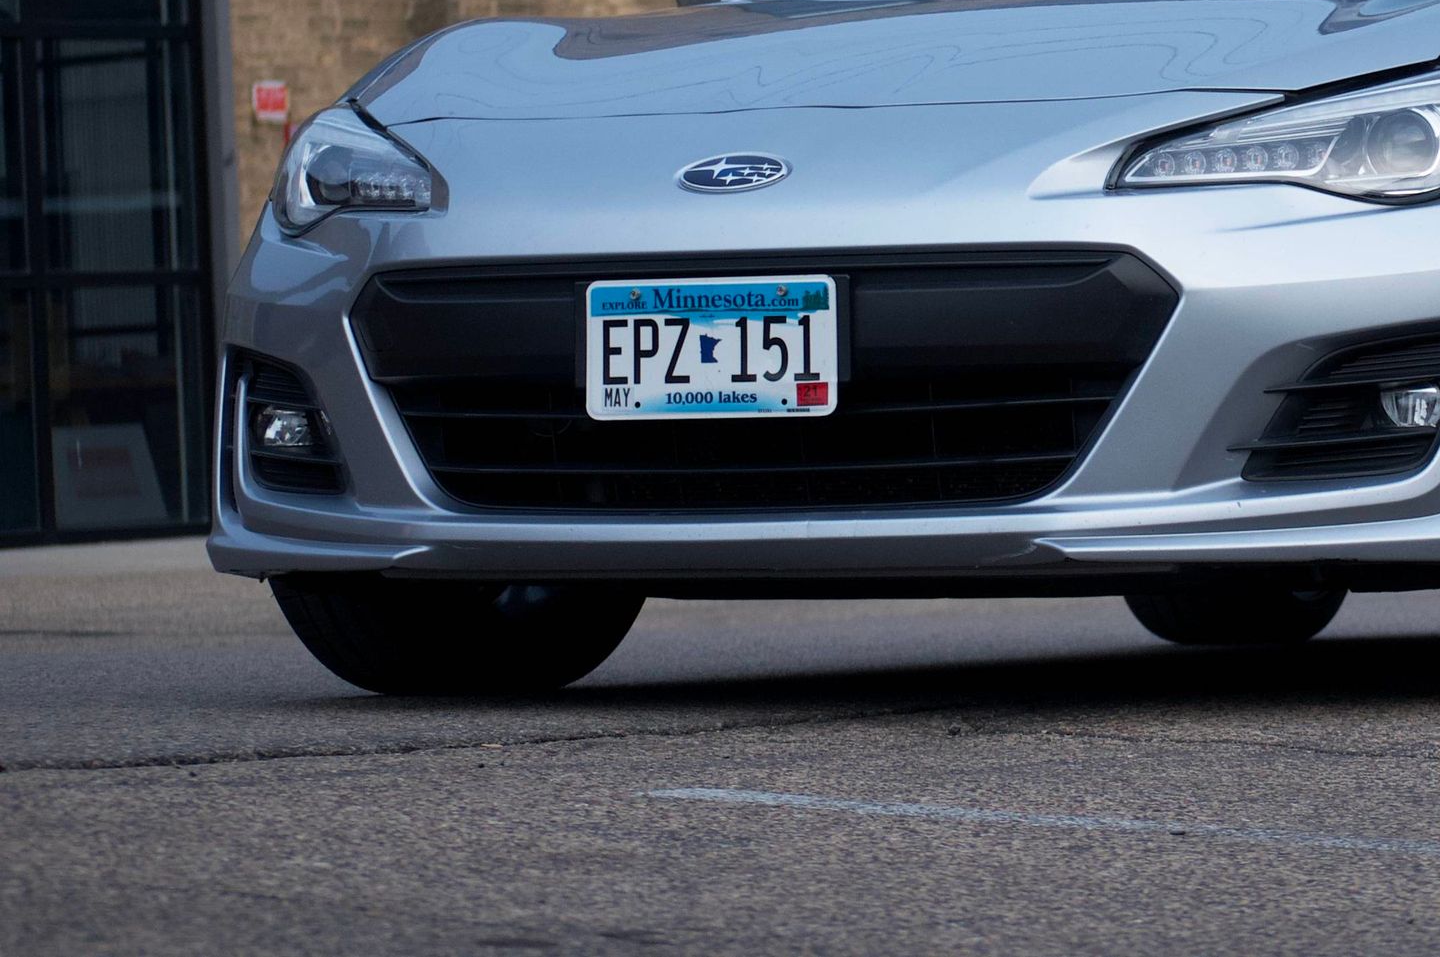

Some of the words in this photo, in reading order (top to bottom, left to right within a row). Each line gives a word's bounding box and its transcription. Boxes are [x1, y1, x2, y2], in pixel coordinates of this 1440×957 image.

[601, 301, 648, 311] EXPLORE
[653, 287, 799, 310] Minnesota.com
[602, 318, 690, 386] EPZ
[731, 314, 820, 384] 151
[604, 387, 631, 408] MAY
[665, 391, 713, 405] 10,000
[718, 390, 757, 404] lakes
